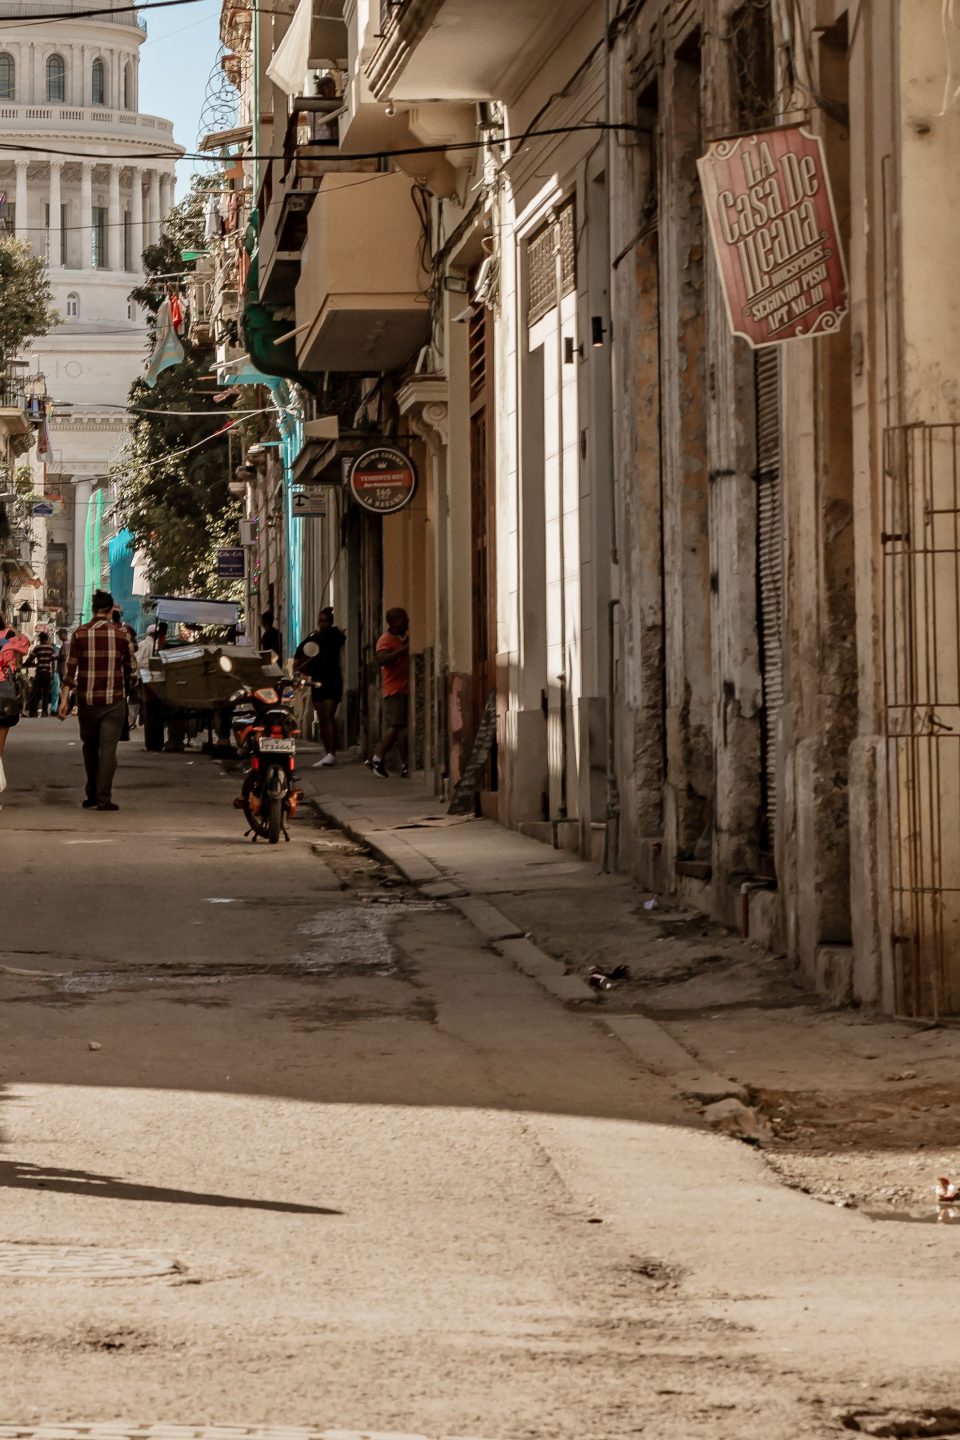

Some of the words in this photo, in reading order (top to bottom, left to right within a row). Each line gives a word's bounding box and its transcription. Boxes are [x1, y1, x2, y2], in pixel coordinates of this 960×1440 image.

[742, 140, 776, 188] LA
[717, 177, 784, 245] Casa
[779, 152, 819, 208] De
[751, 280, 800, 322] SEGUNDO
[801, 263, 827, 291] PISO
[767, 305, 789, 331] APT
